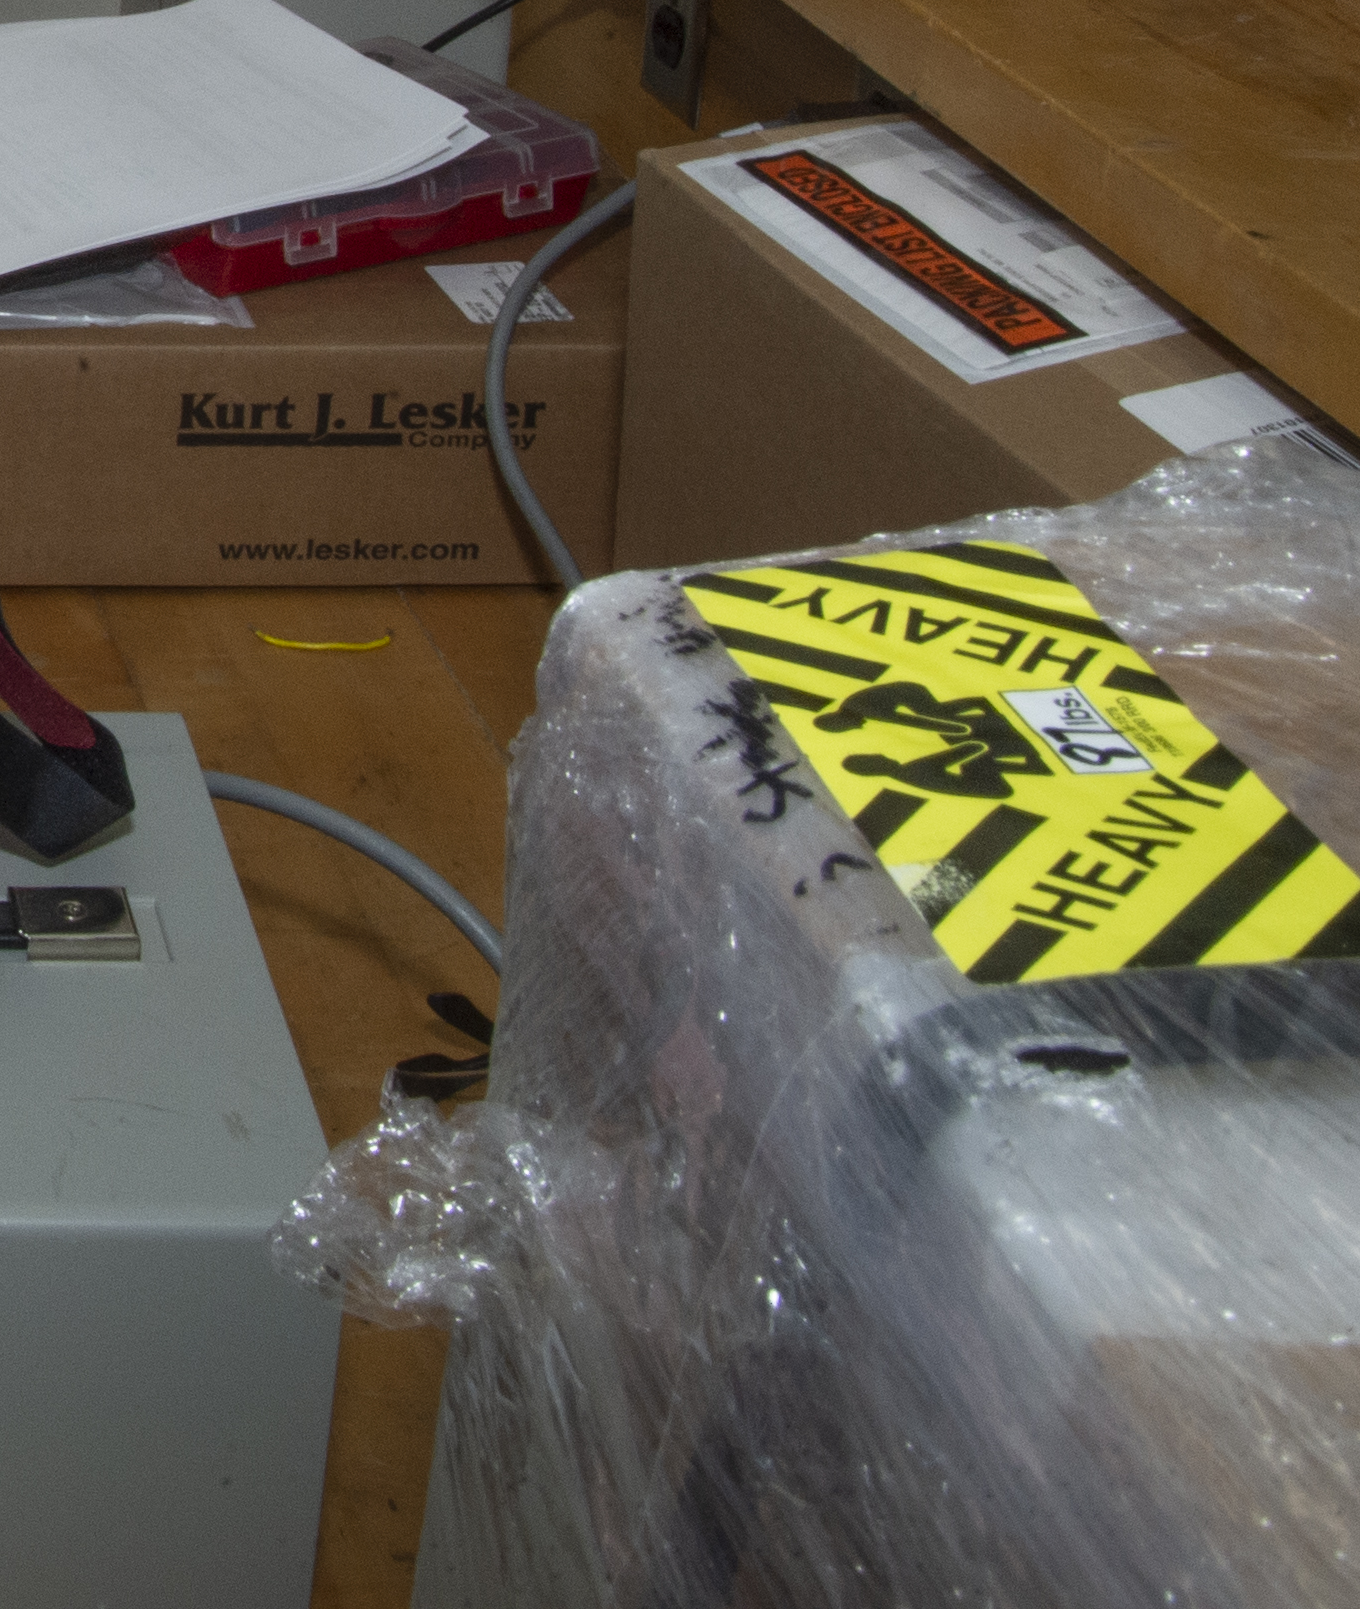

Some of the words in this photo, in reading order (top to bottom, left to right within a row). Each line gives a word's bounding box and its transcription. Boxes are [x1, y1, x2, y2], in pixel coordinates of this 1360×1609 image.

[780, 166, 899, 235] ENCLOSED
[875, 229, 941, 274] LIST
[920, 262, 1041, 332] PACKING
[177, 392, 294, 431] Kurt
[312, 393, 345, 442] J.
[370, 391, 546, 431] Lesker
[408, 430, 536, 452] Compny
[218, 538, 480, 562] www.lesker.com
[768, 587, 1101, 684] HEAVY
[1053, 692, 1100, 726] lbs.
[1012, 771, 1225, 933] HEAVY
